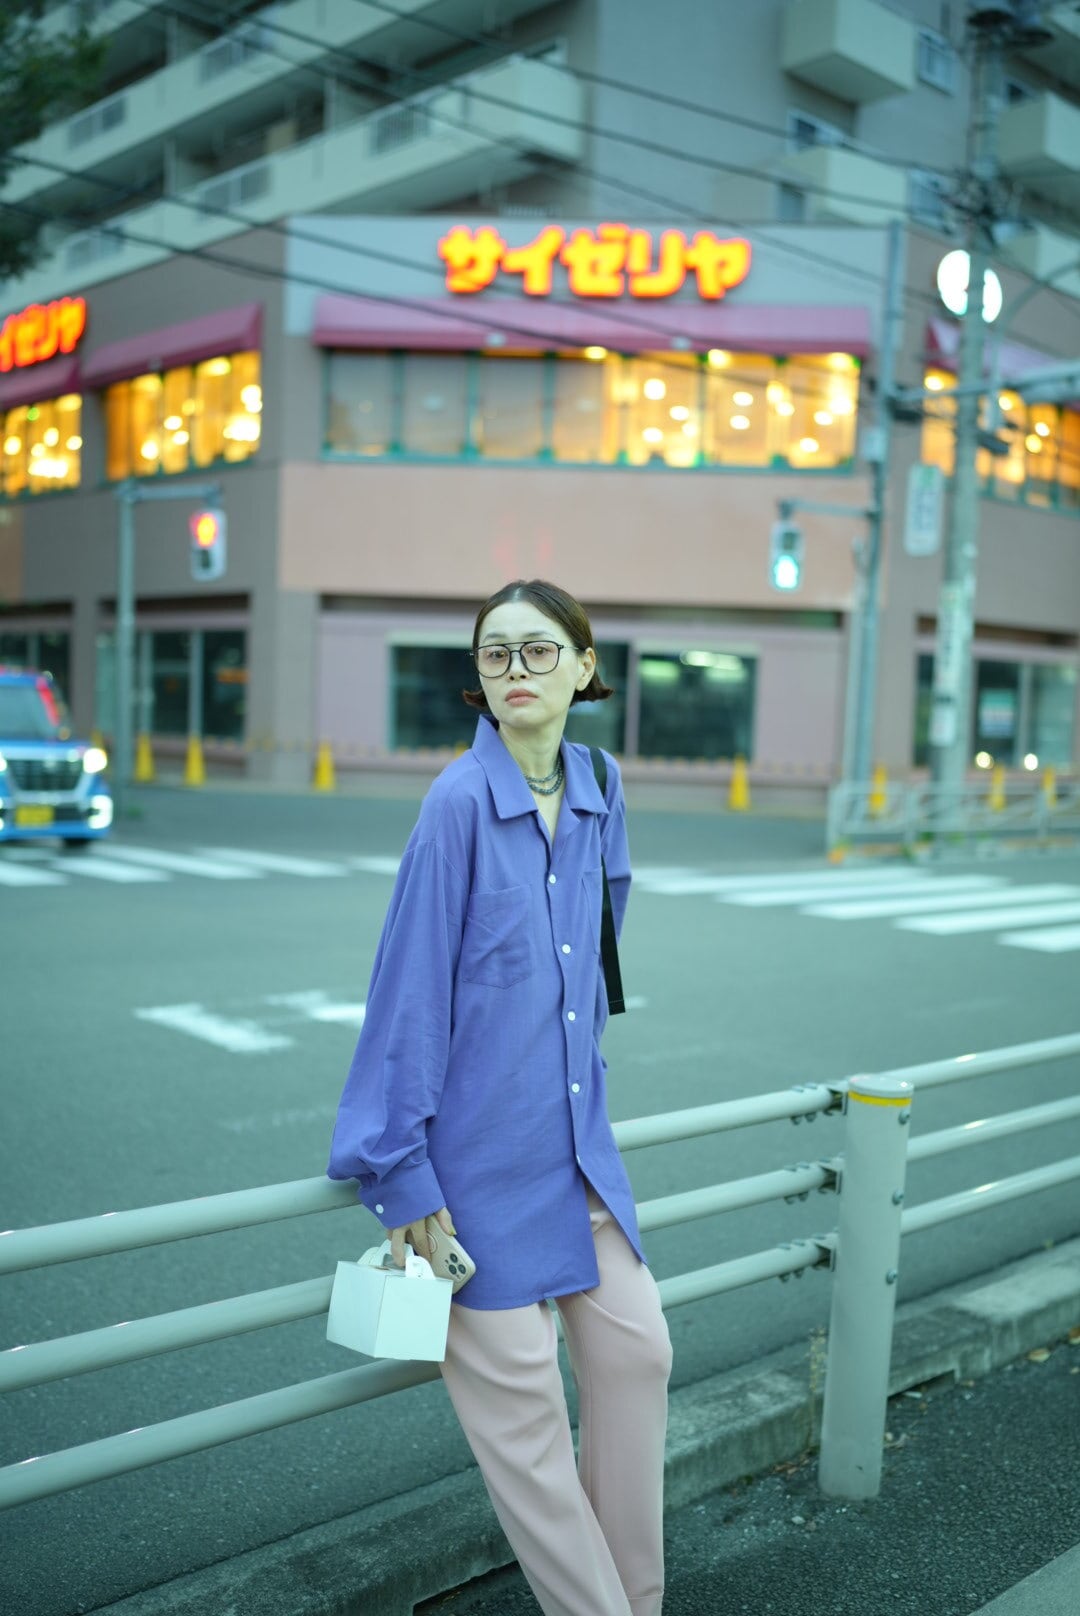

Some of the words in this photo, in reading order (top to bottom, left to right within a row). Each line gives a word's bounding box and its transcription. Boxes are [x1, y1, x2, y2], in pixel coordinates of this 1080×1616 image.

[438, 223, 751, 301] サイゼリヤ
